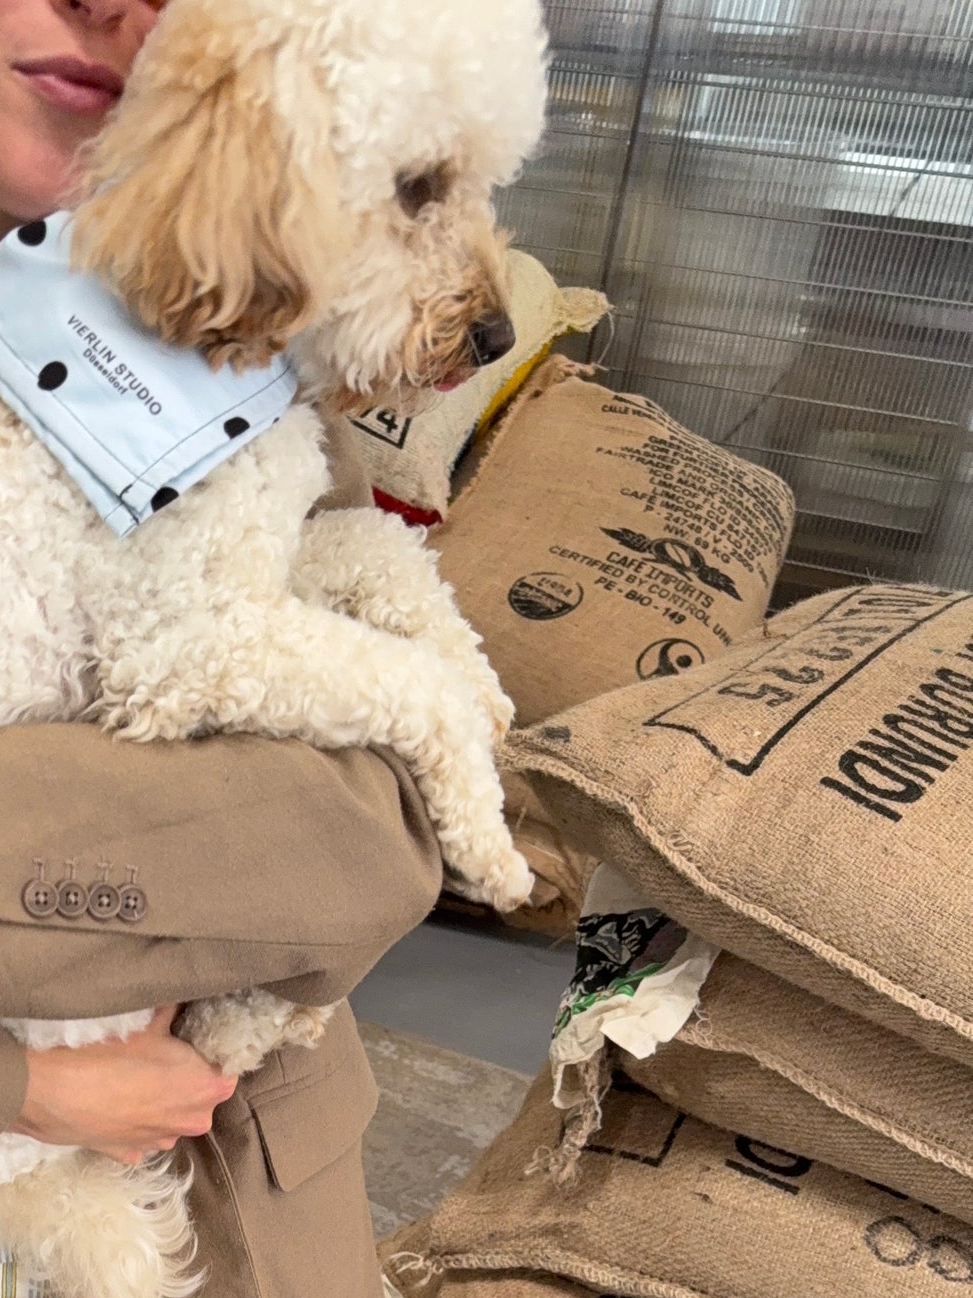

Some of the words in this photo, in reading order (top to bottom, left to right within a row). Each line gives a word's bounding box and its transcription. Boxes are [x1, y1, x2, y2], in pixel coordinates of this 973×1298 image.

[67, 314, 117, 364] VIERLIN
[114, 363, 162, 415] STUDIO
[83, 347, 128, 395] Düsseldorf
[595, 447, 675, 472] FAIRTRADE
[677, 469, 707, 484] AND
[643, 442, 670, 455] FOR
[647, 435, 694, 455] GREEN
[620, 446, 680, 466] WASHED
[683, 463, 745, 498] PROCESS
[649, 468, 675, 481] ICO
[677, 477, 717, 500] MARK
[649, 477, 700, 499] LIMCOF
[703, 498, 727, 515] FLO
[729, 513, 741, 526] ID
[651, 486, 705, 511] LIMCOF
[706, 509, 725, 525] CU
[660, 500, 718, 531] IMPORTS
[719, 529, 742, 549] FLO
[744, 548, 755, 561] ID
[711, 546, 731, 564] KG
[549, 545, 624, 577] CERTIFIED
[625, 573, 648, 588] BY
[647, 583, 711, 628] CONTROL
[594, 576, 618, 591] PE
[625, 589, 653, 607] BIO
[662, 607, 687, 625] 149
[645, 565, 715, 609] IMPORTS
